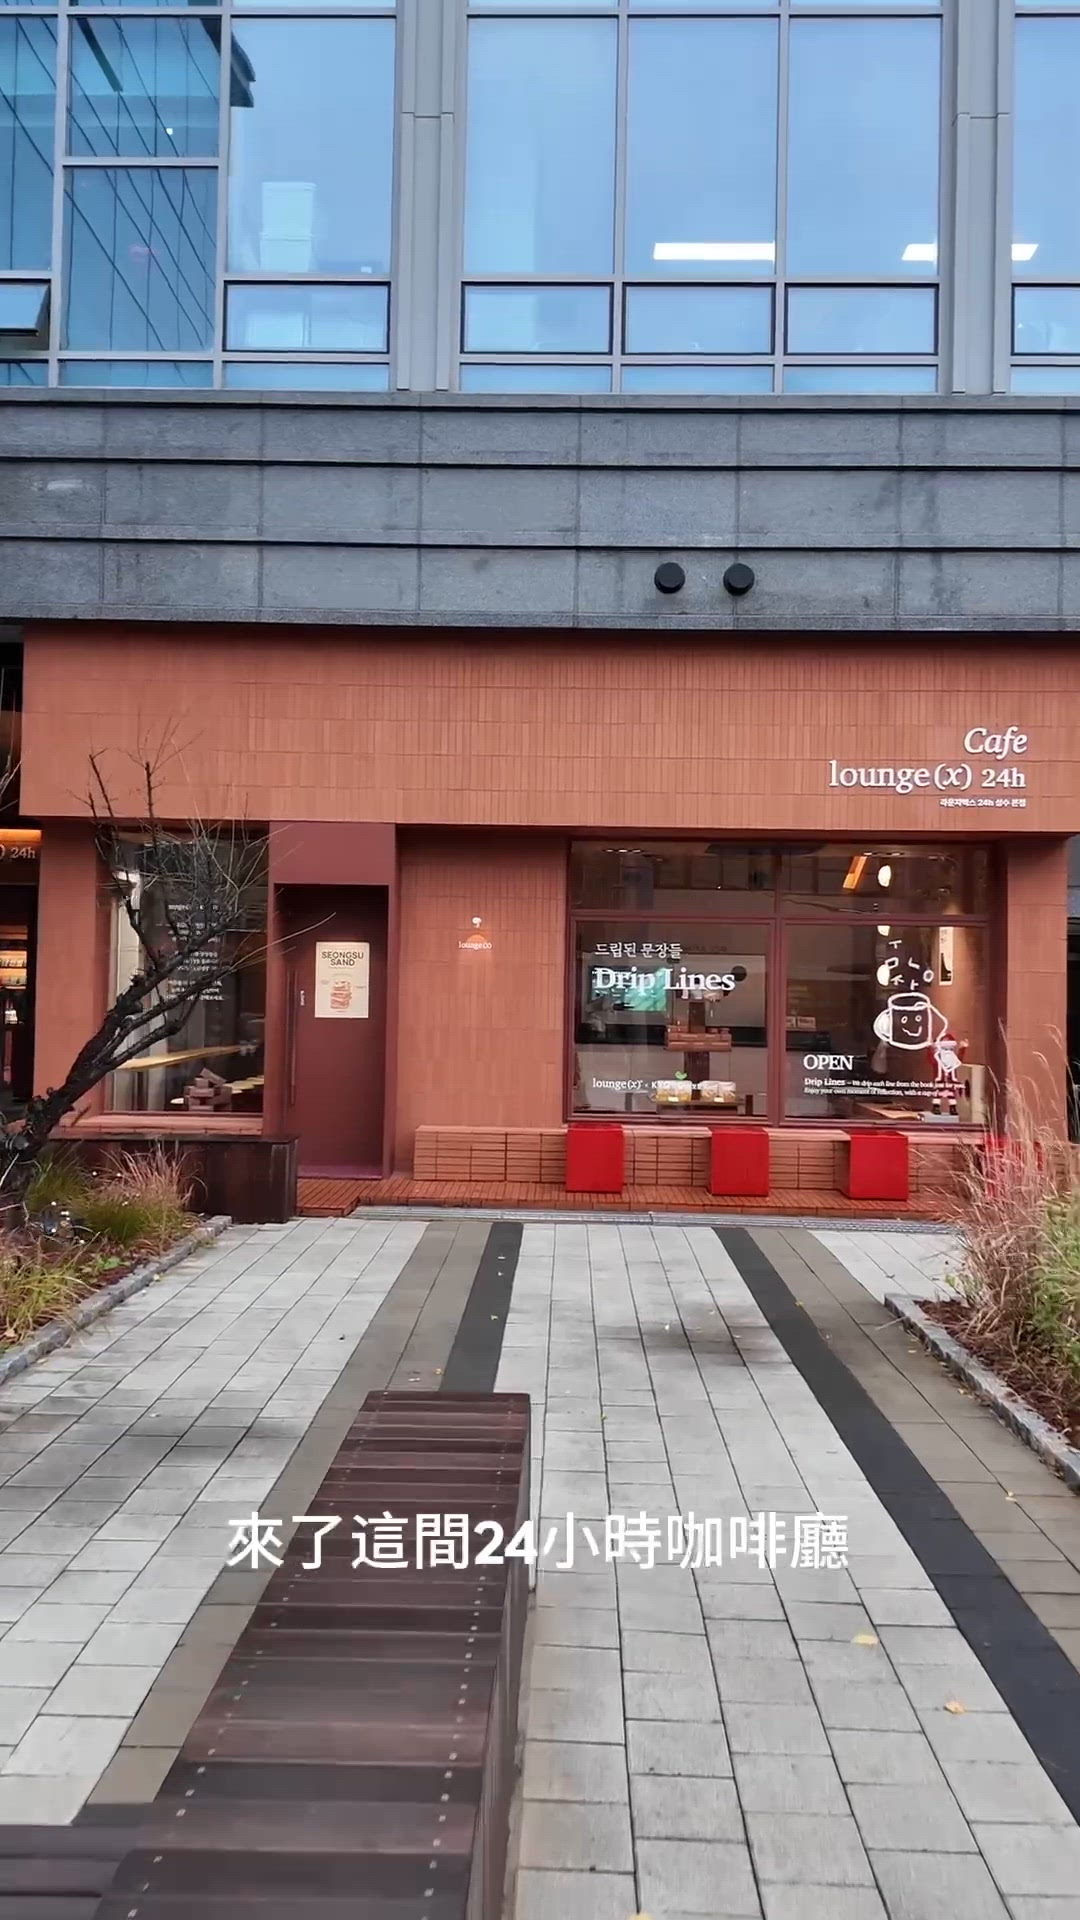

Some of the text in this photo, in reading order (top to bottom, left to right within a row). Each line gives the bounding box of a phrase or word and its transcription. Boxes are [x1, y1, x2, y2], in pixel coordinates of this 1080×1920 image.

[964, 726, 1028, 759] Cafe
[829, 760, 1026, 794] lounge(x) 24h
[977, 798, 994, 807] 24h
[10, 846, 36, 859] 24h
[321, 951, 364, 960] SEONGSU
[594, 942, 683, 959] 드립된 문장들
[330, 959, 356, 967] SAND
[592, 966, 736, 996] Drip Lines
[803, 1054, 854, 1070] OPEN
[804, 1077, 822, 1087] Drip
[824, 1077, 846, 1086] Lines
